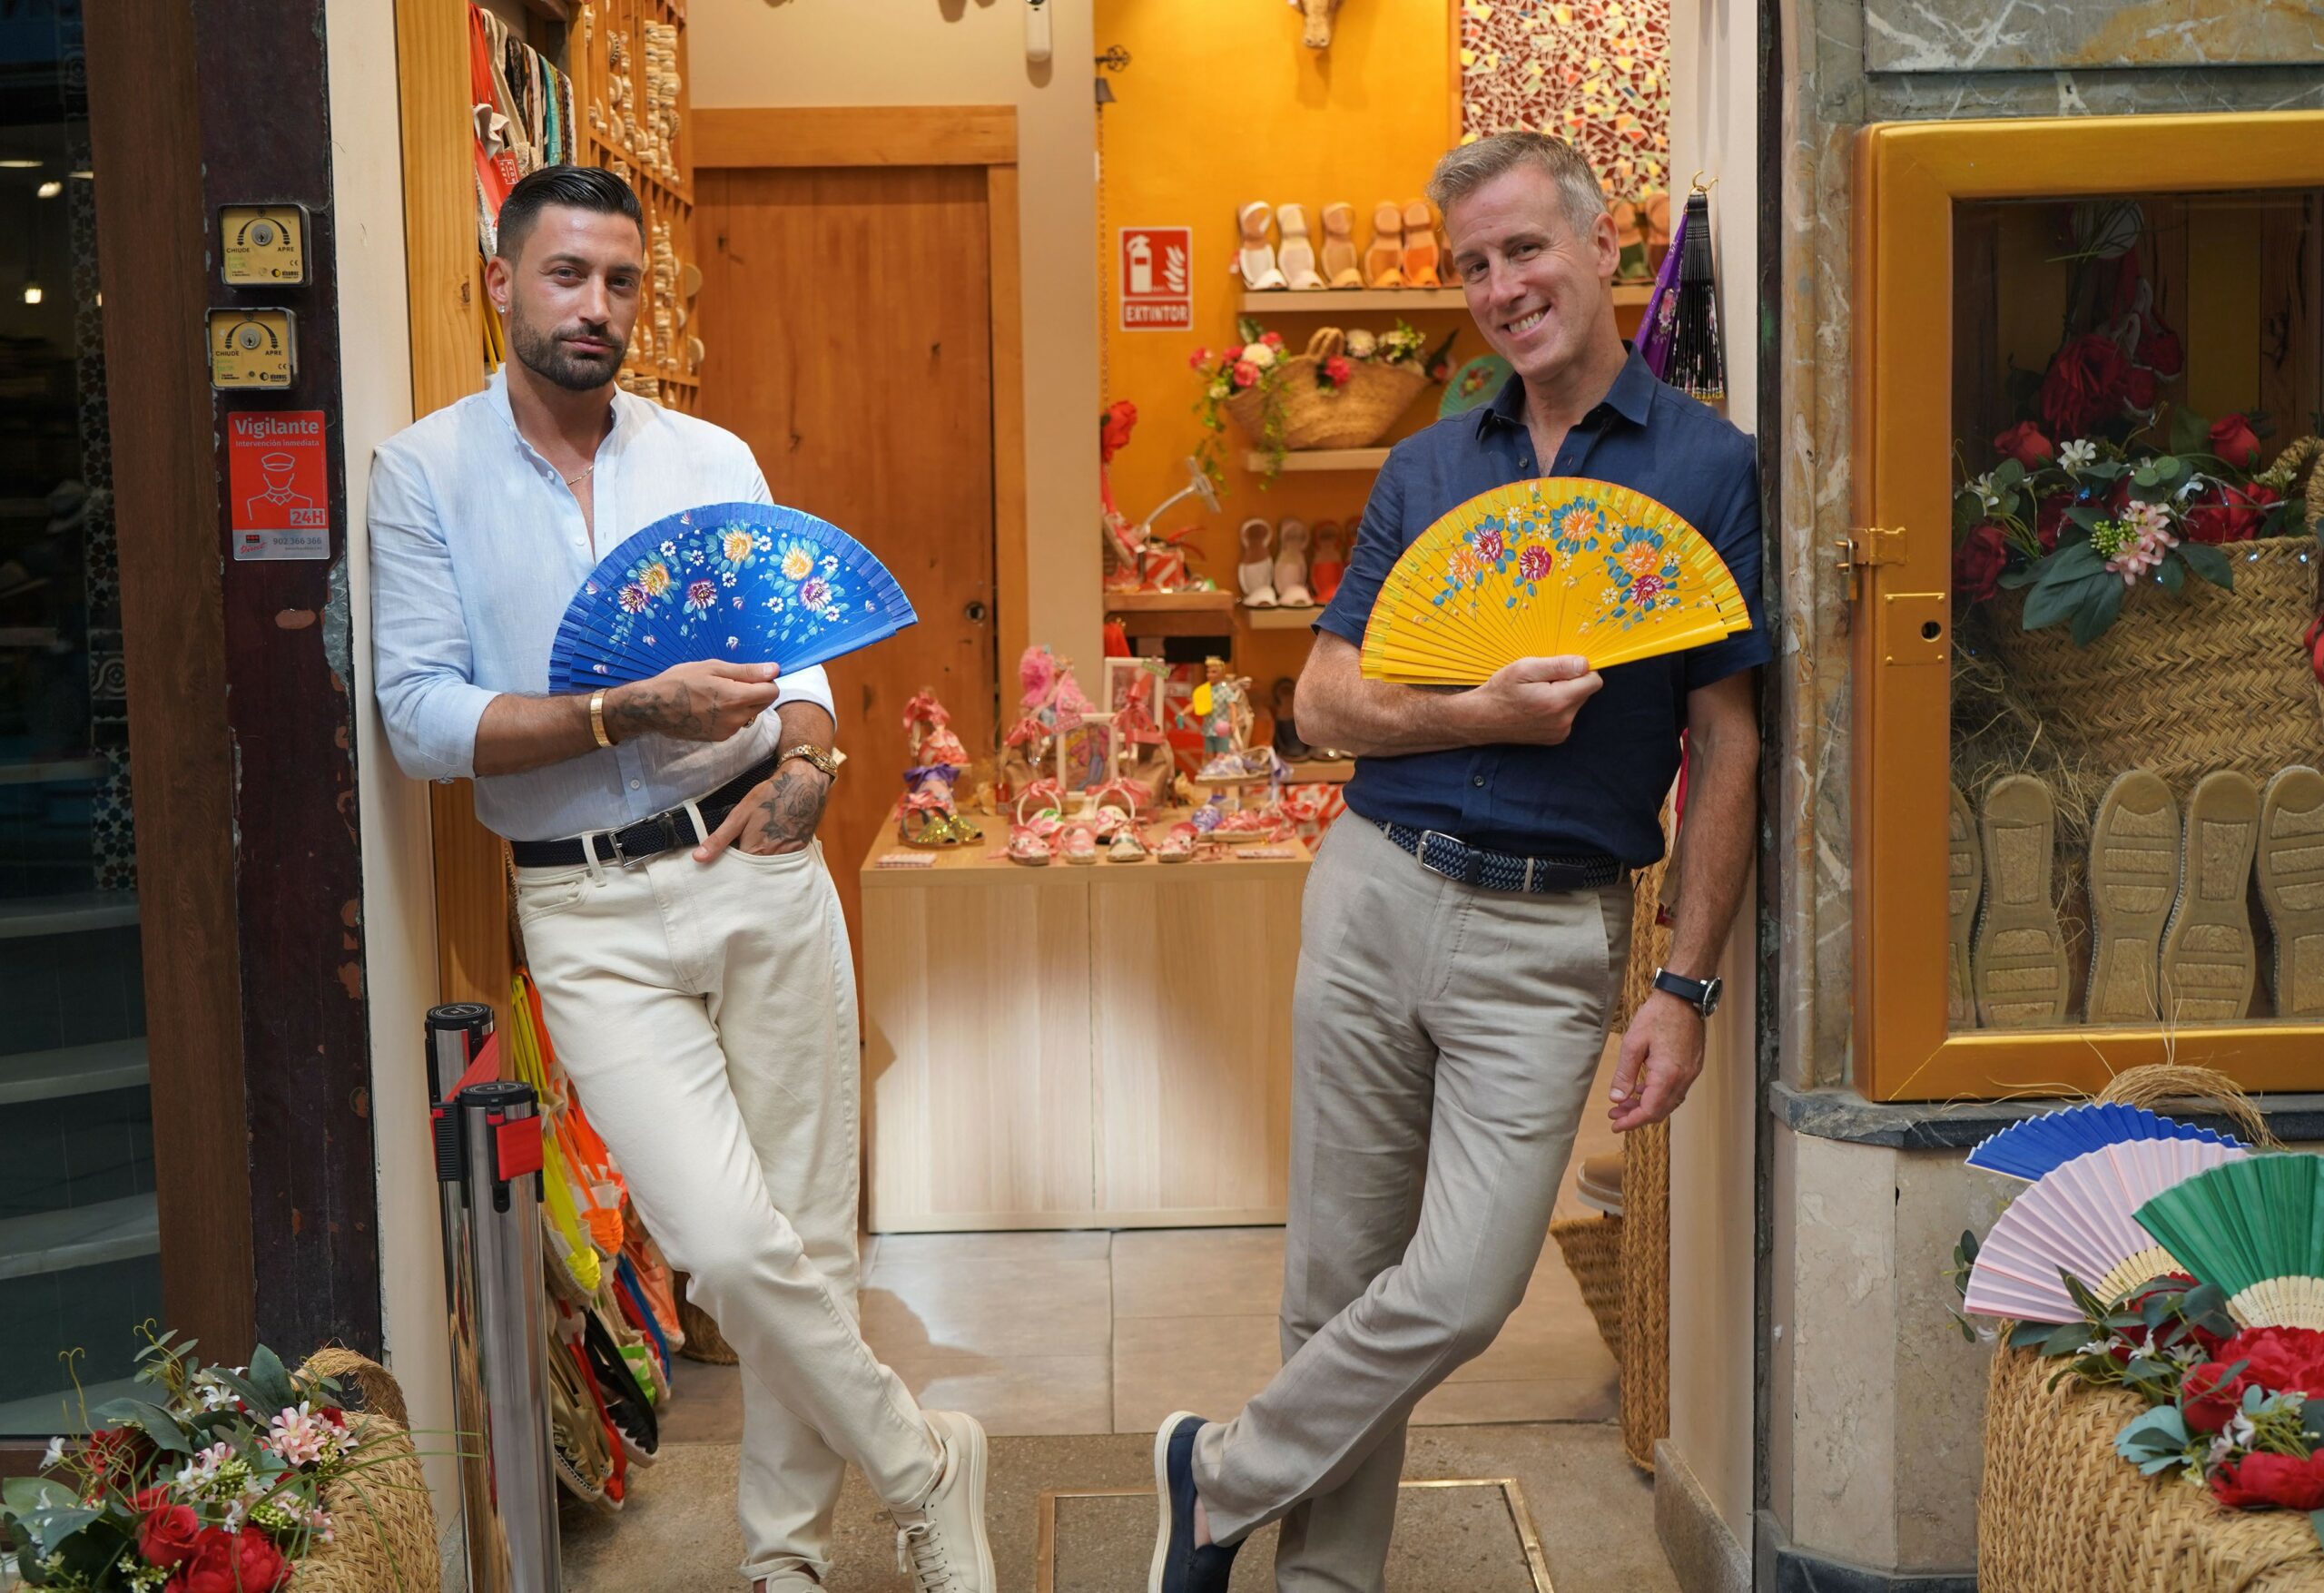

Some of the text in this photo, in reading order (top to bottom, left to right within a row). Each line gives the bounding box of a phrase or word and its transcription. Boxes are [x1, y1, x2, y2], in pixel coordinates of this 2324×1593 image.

[1125, 305, 1188, 322] EXTINTOR
[234, 418, 320, 438] Vigilante
[235, 439, 320, 447] Intervención inmediata
[292, 510, 323, 525] 24H
